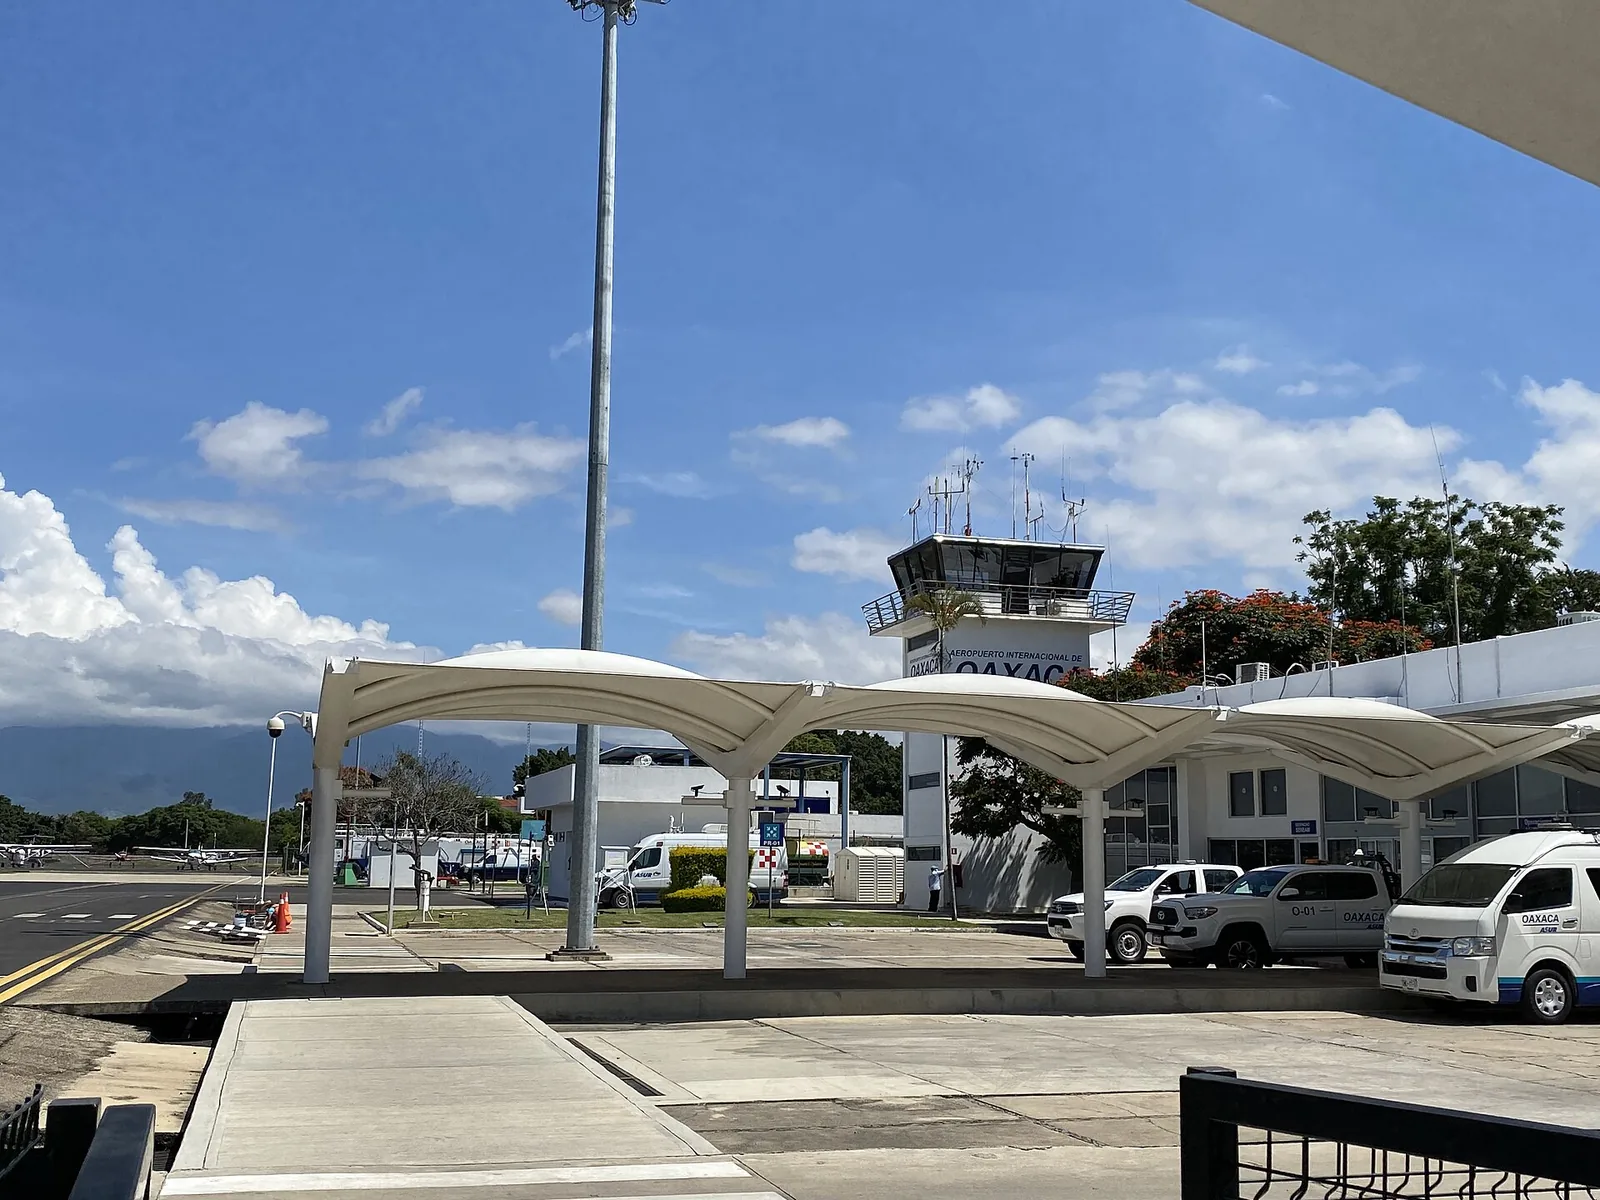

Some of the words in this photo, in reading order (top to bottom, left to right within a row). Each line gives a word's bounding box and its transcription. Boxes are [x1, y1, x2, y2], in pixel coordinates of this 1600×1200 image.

[950, 649, 1005, 658] AEROPUERTO
[1005, 651, 1069, 662] INTERNACIONAL
[1071, 654, 1083, 662] DE
[910, 657, 940, 678] OAXACA
[955, 660, 1080, 684] OAXAC
[1343, 912, 1385, 922] OAXACA
[1522, 914, 1559, 924] OAXACA
